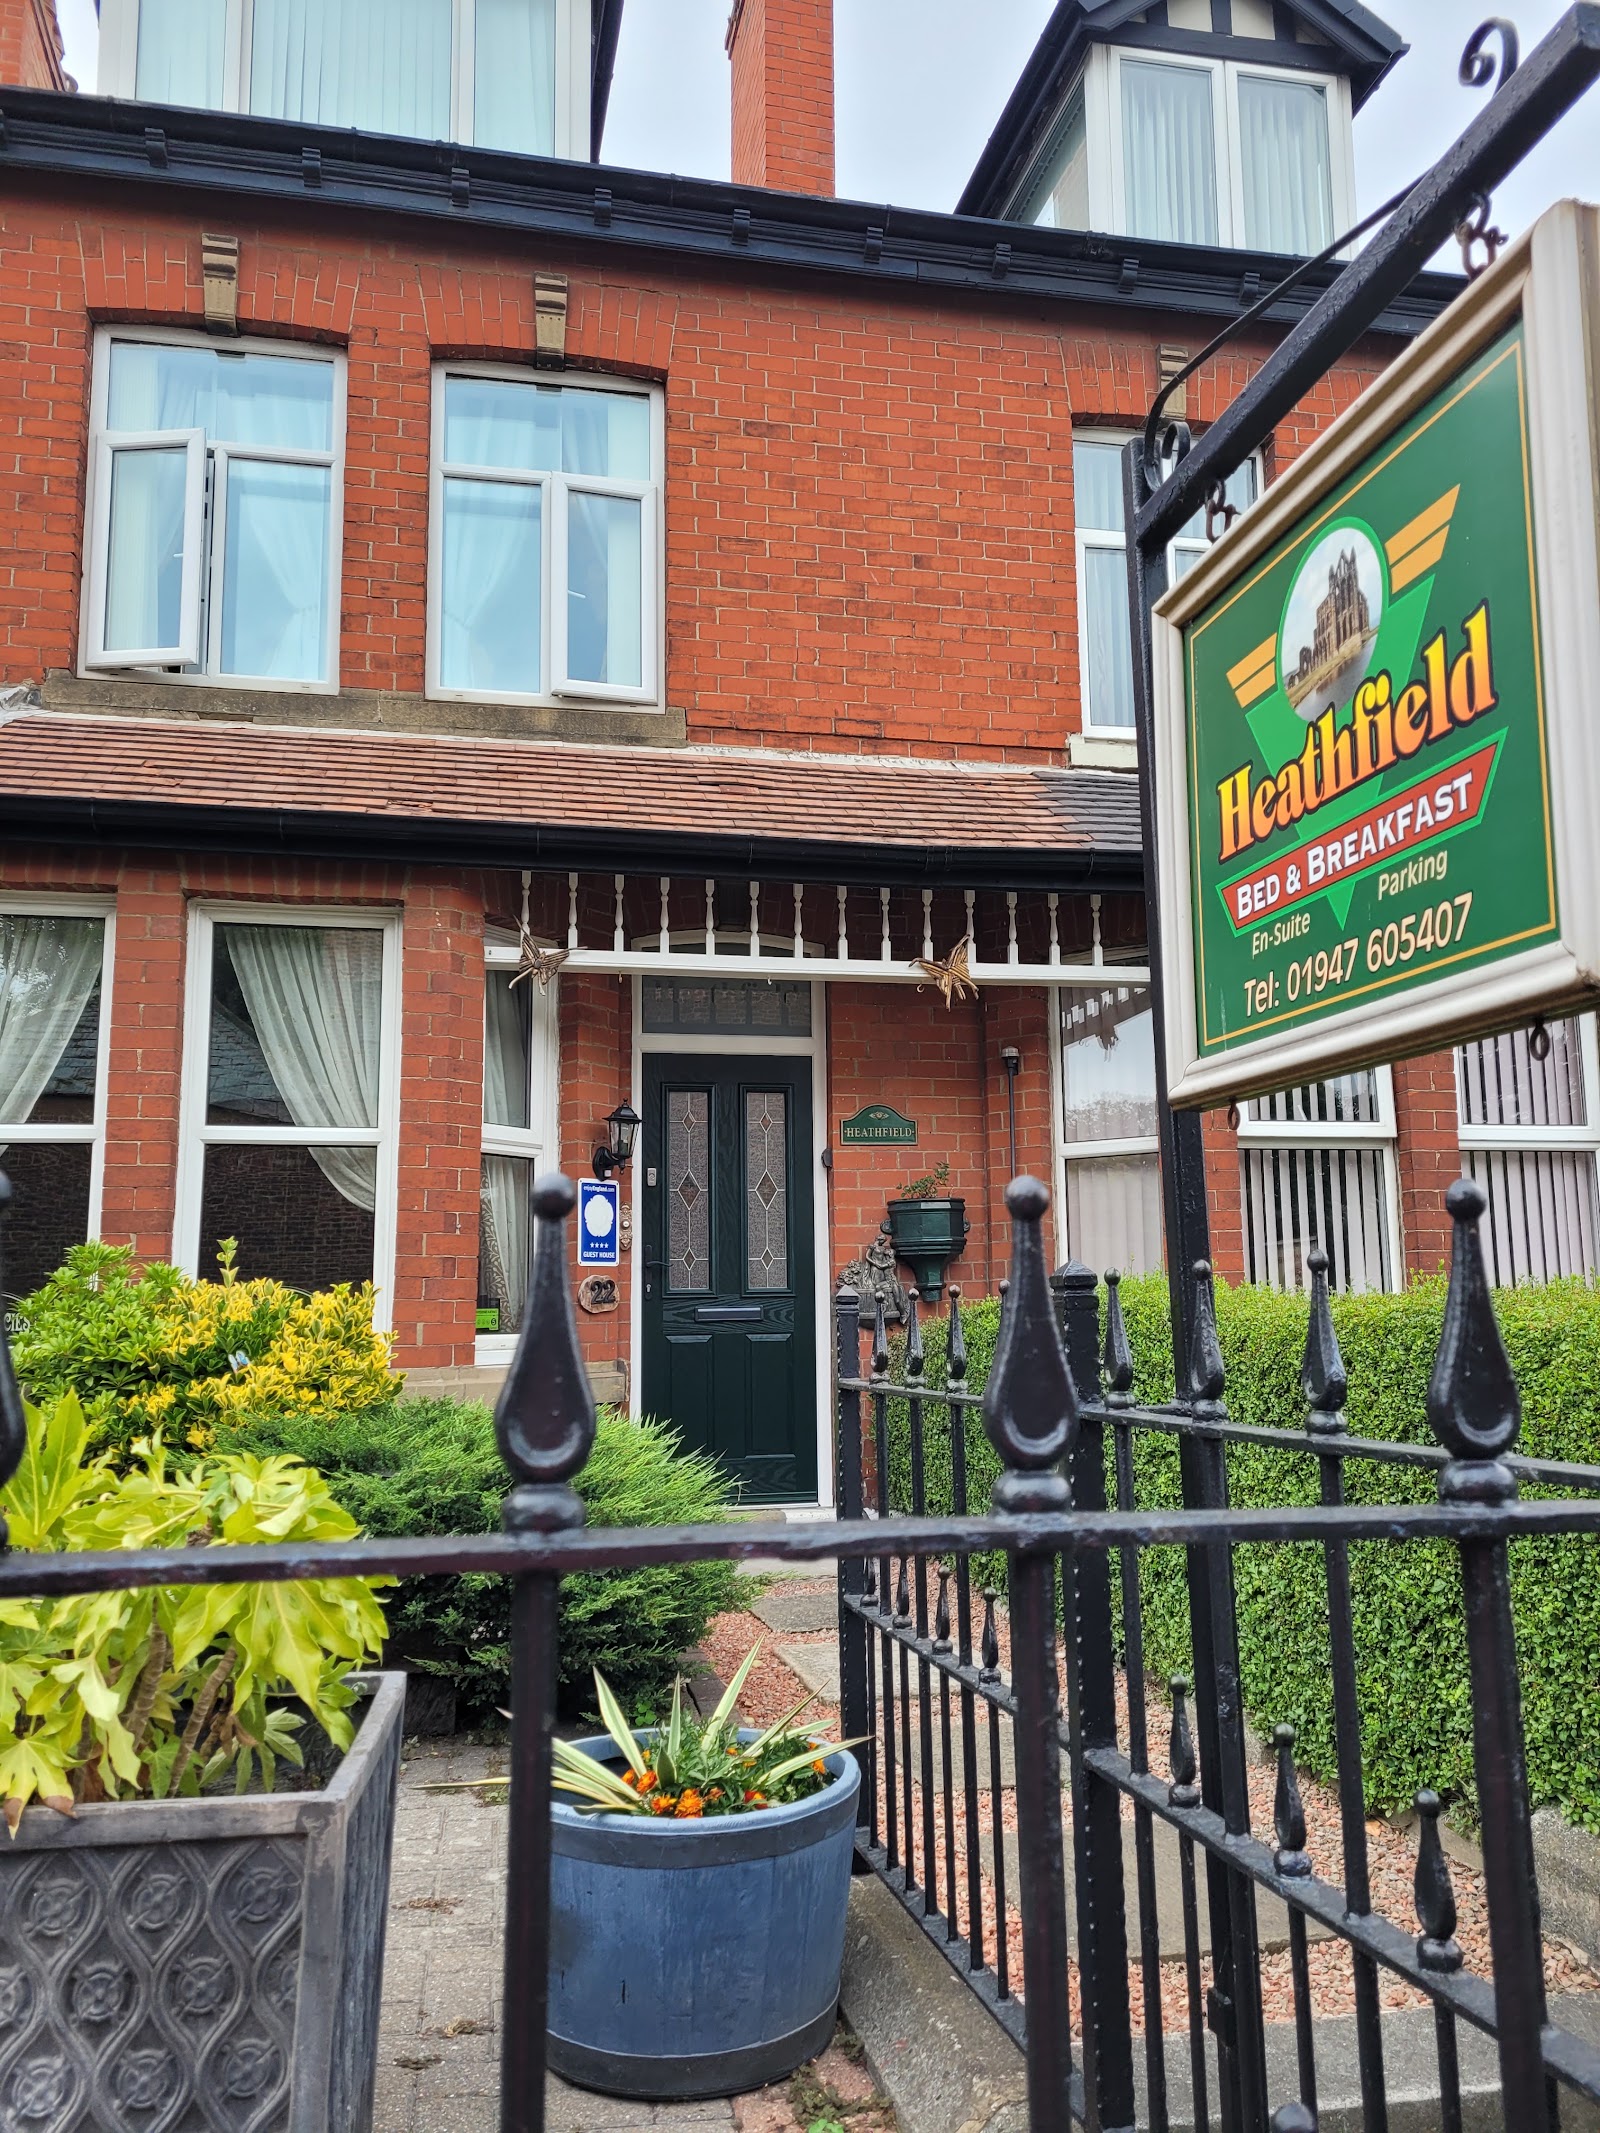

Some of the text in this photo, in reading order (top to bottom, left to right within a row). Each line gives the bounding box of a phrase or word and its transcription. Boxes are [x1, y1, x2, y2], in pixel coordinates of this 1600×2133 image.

[1217, 599, 1498, 864] Heathfield
[1236, 771, 1473, 920] BED & BREAKFAST
[1378, 850, 1448, 901] Parking
[1244, 892, 1473, 1017] Tel: 01947 605407
[1252, 912, 1311, 958] En-Suite
[846, 1127, 912, 1138] HEATHFIELD
[599, 1251, 616, 1259] HOUSE
[591, 1280, 616, 1304] 22
